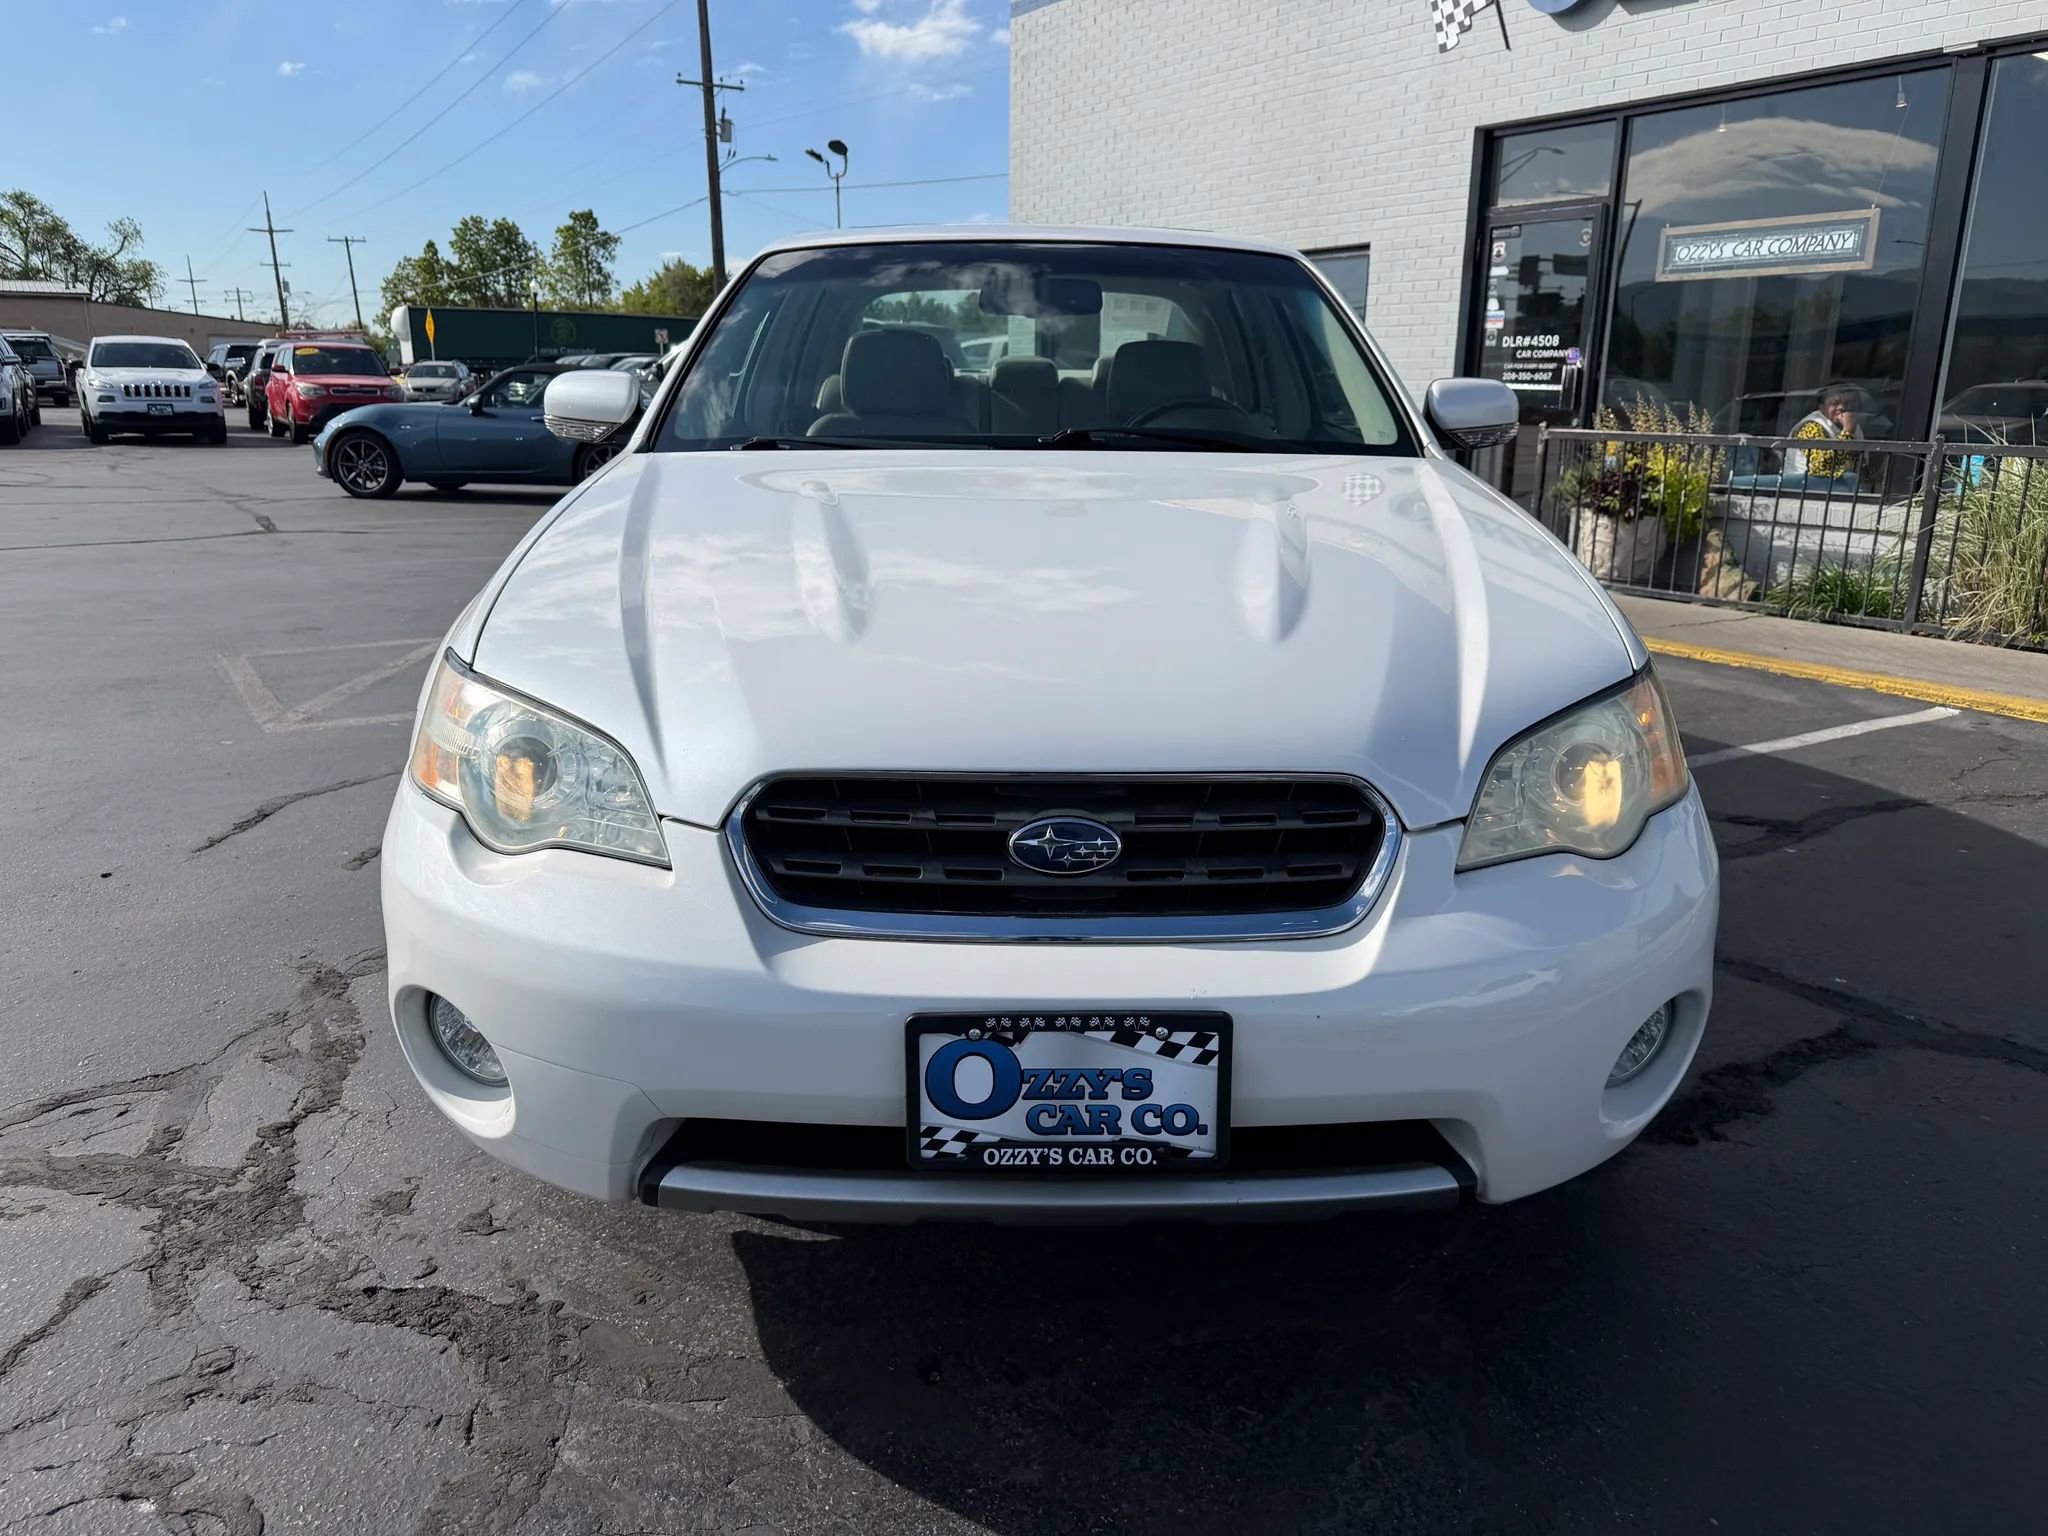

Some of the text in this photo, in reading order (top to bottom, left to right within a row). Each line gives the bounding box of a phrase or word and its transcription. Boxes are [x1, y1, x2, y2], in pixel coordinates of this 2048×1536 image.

[1677, 232, 1853, 261] OZZY'S CAR COMPANY
[1502, 334, 1560, 347] DLR#4508
[1516, 349, 1532, 358] CAR
[925, 1039, 1153, 1121] OZZY'S
[1025, 1103, 1208, 1136] CAR CO.
[983, 1147, 1157, 1166] OZZY'S CAR CO.
